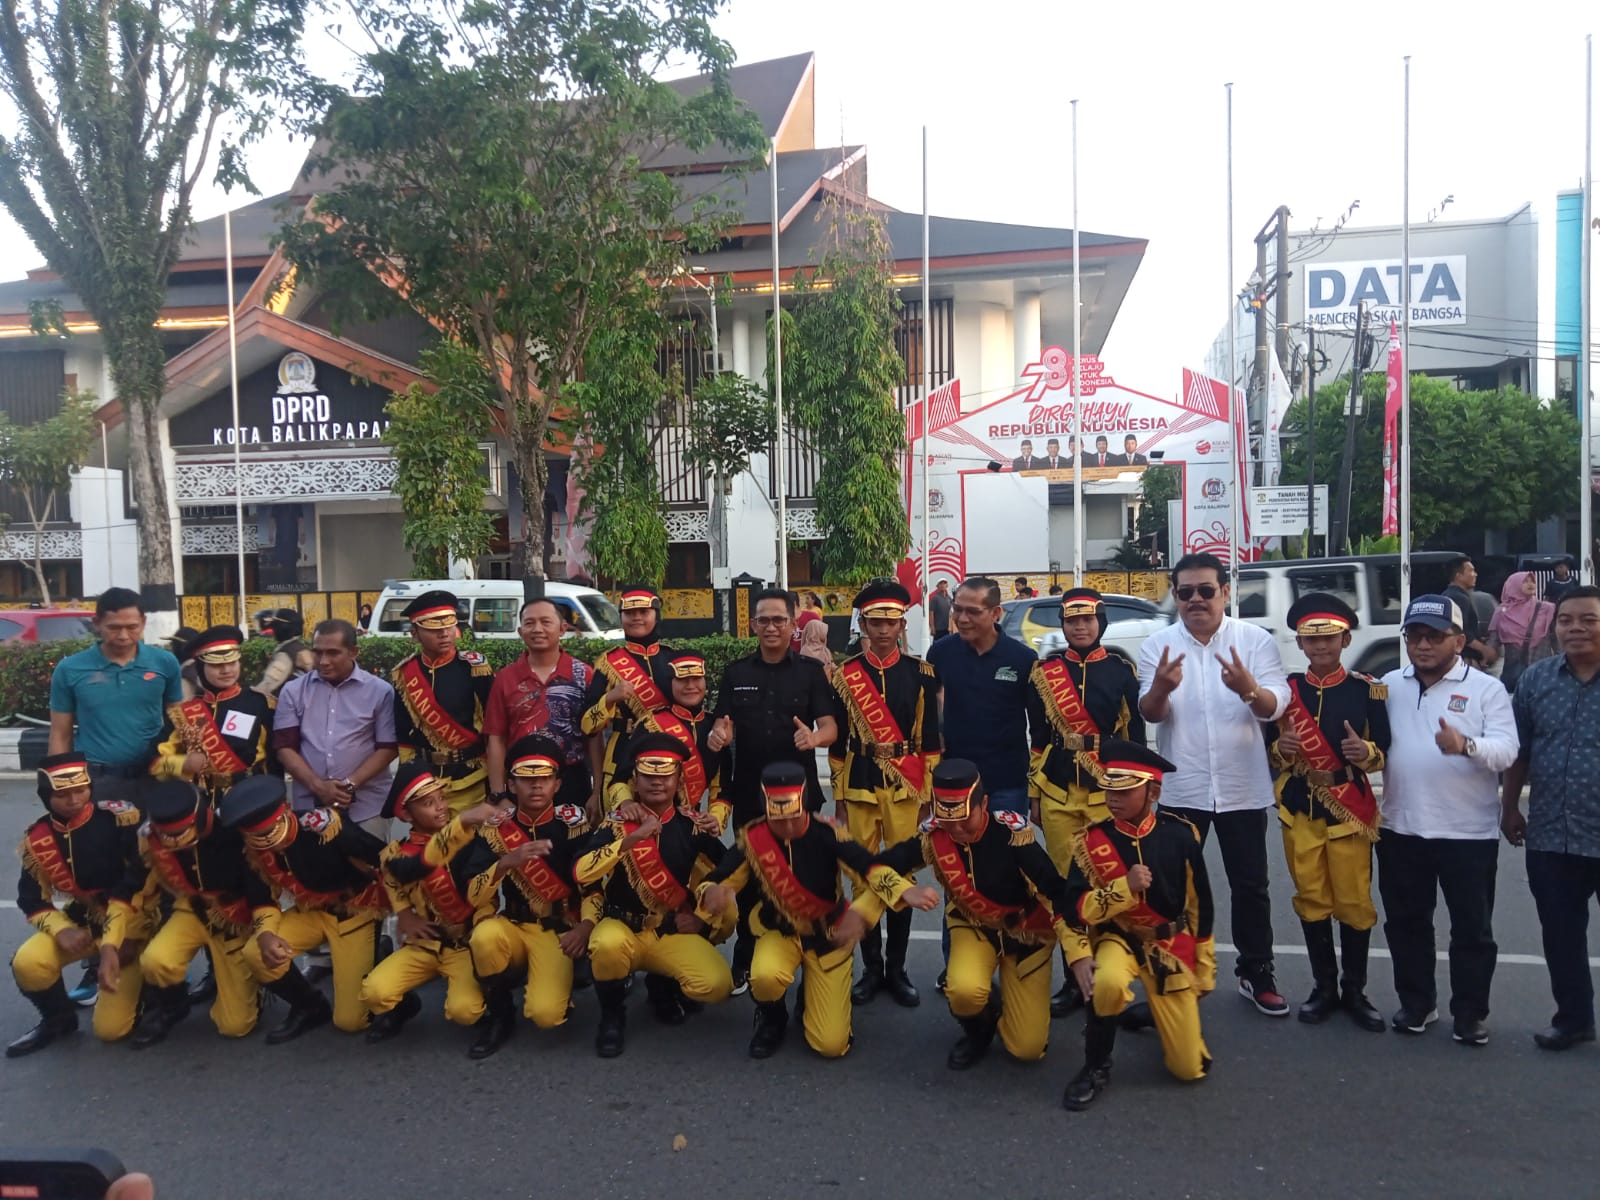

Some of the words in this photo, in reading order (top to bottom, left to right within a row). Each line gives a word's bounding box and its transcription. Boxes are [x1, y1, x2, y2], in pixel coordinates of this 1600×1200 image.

[1308, 263, 1462, 309] DATA
[1411, 307, 1462, 321] BANGSA
[272, 395, 330, 424] DPRD
[213, 427, 261, 445] KOTA
[272, 421, 391, 443] BALIKPAPA
[988, 424, 1071, 437] REPUBLIK
[1078, 416, 1168, 432] NDONESIA
[226, 714, 237, 731] 6
